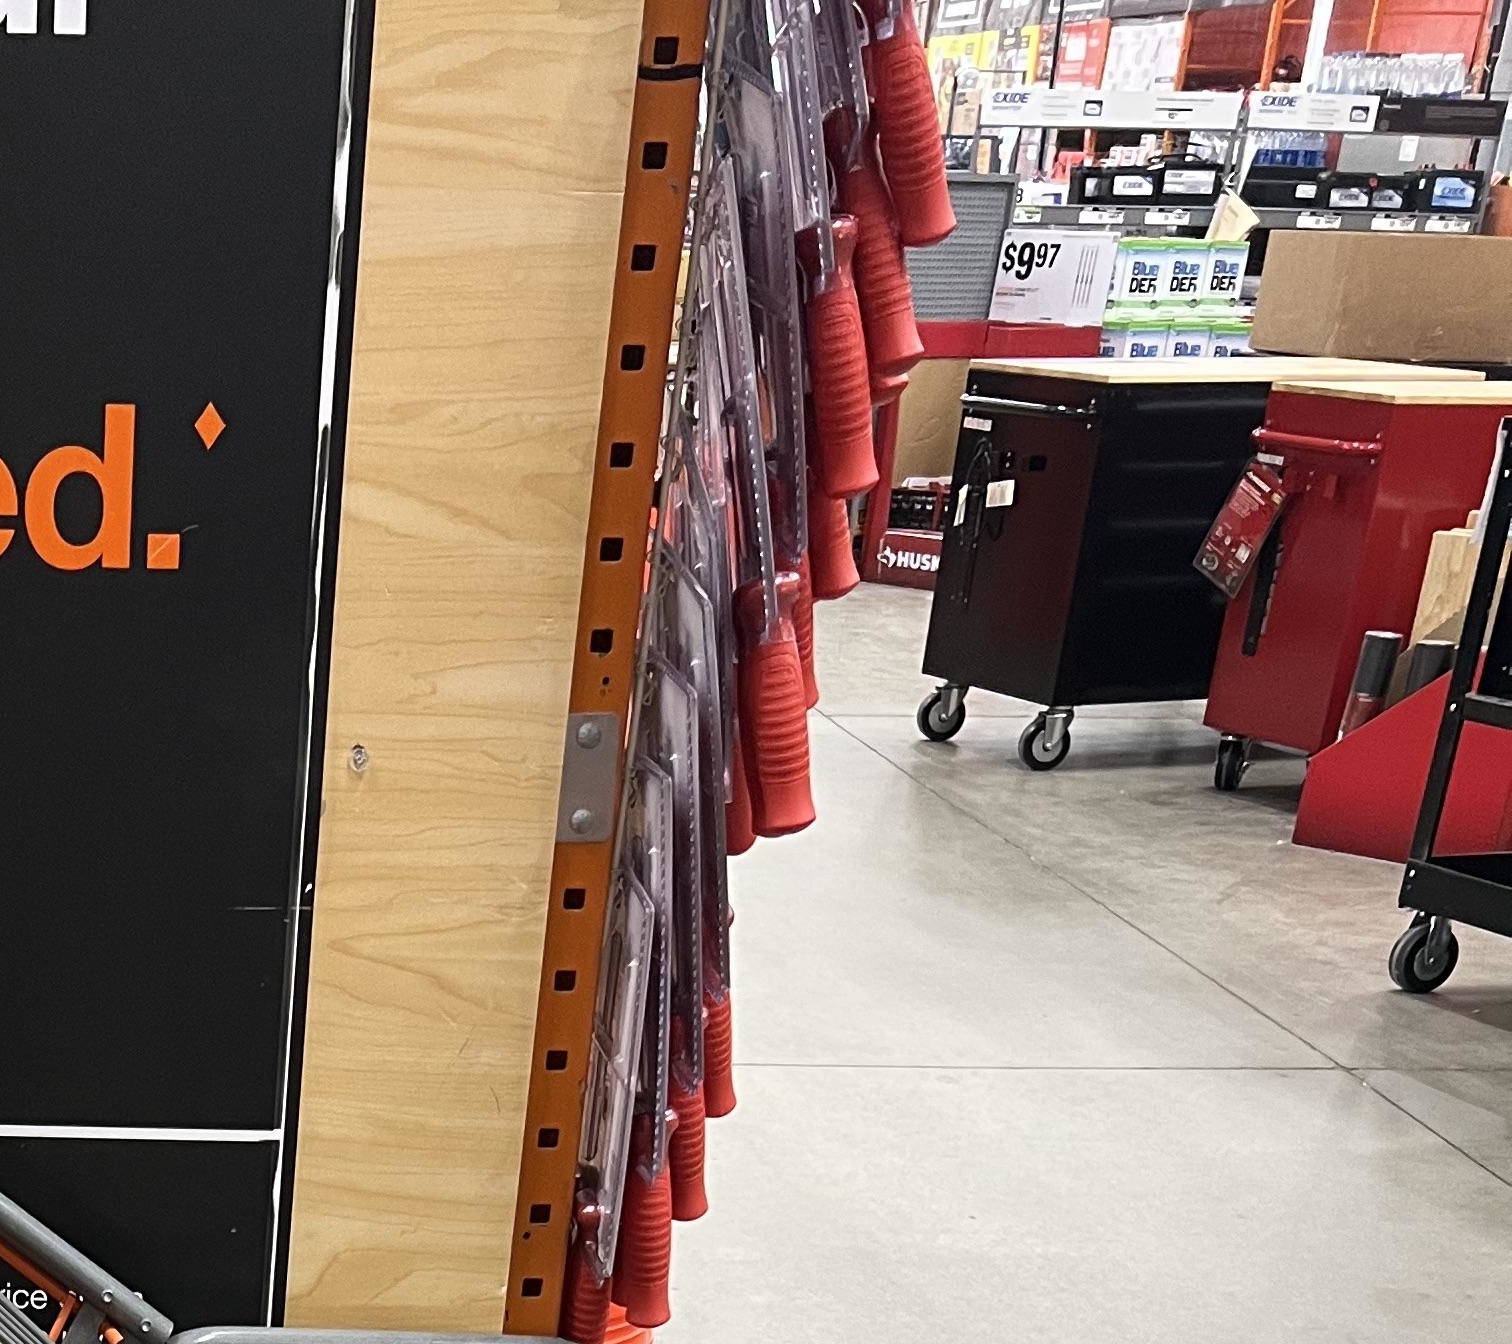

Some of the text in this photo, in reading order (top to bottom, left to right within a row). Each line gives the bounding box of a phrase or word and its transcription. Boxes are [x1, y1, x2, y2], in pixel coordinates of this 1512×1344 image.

[992, 92, 1031, 103] EXIDE
[1132, 261, 1159, 276] Blue
[1173, 260, 1200, 275] Blue
[1213, 259, 1240, 274] Blue
